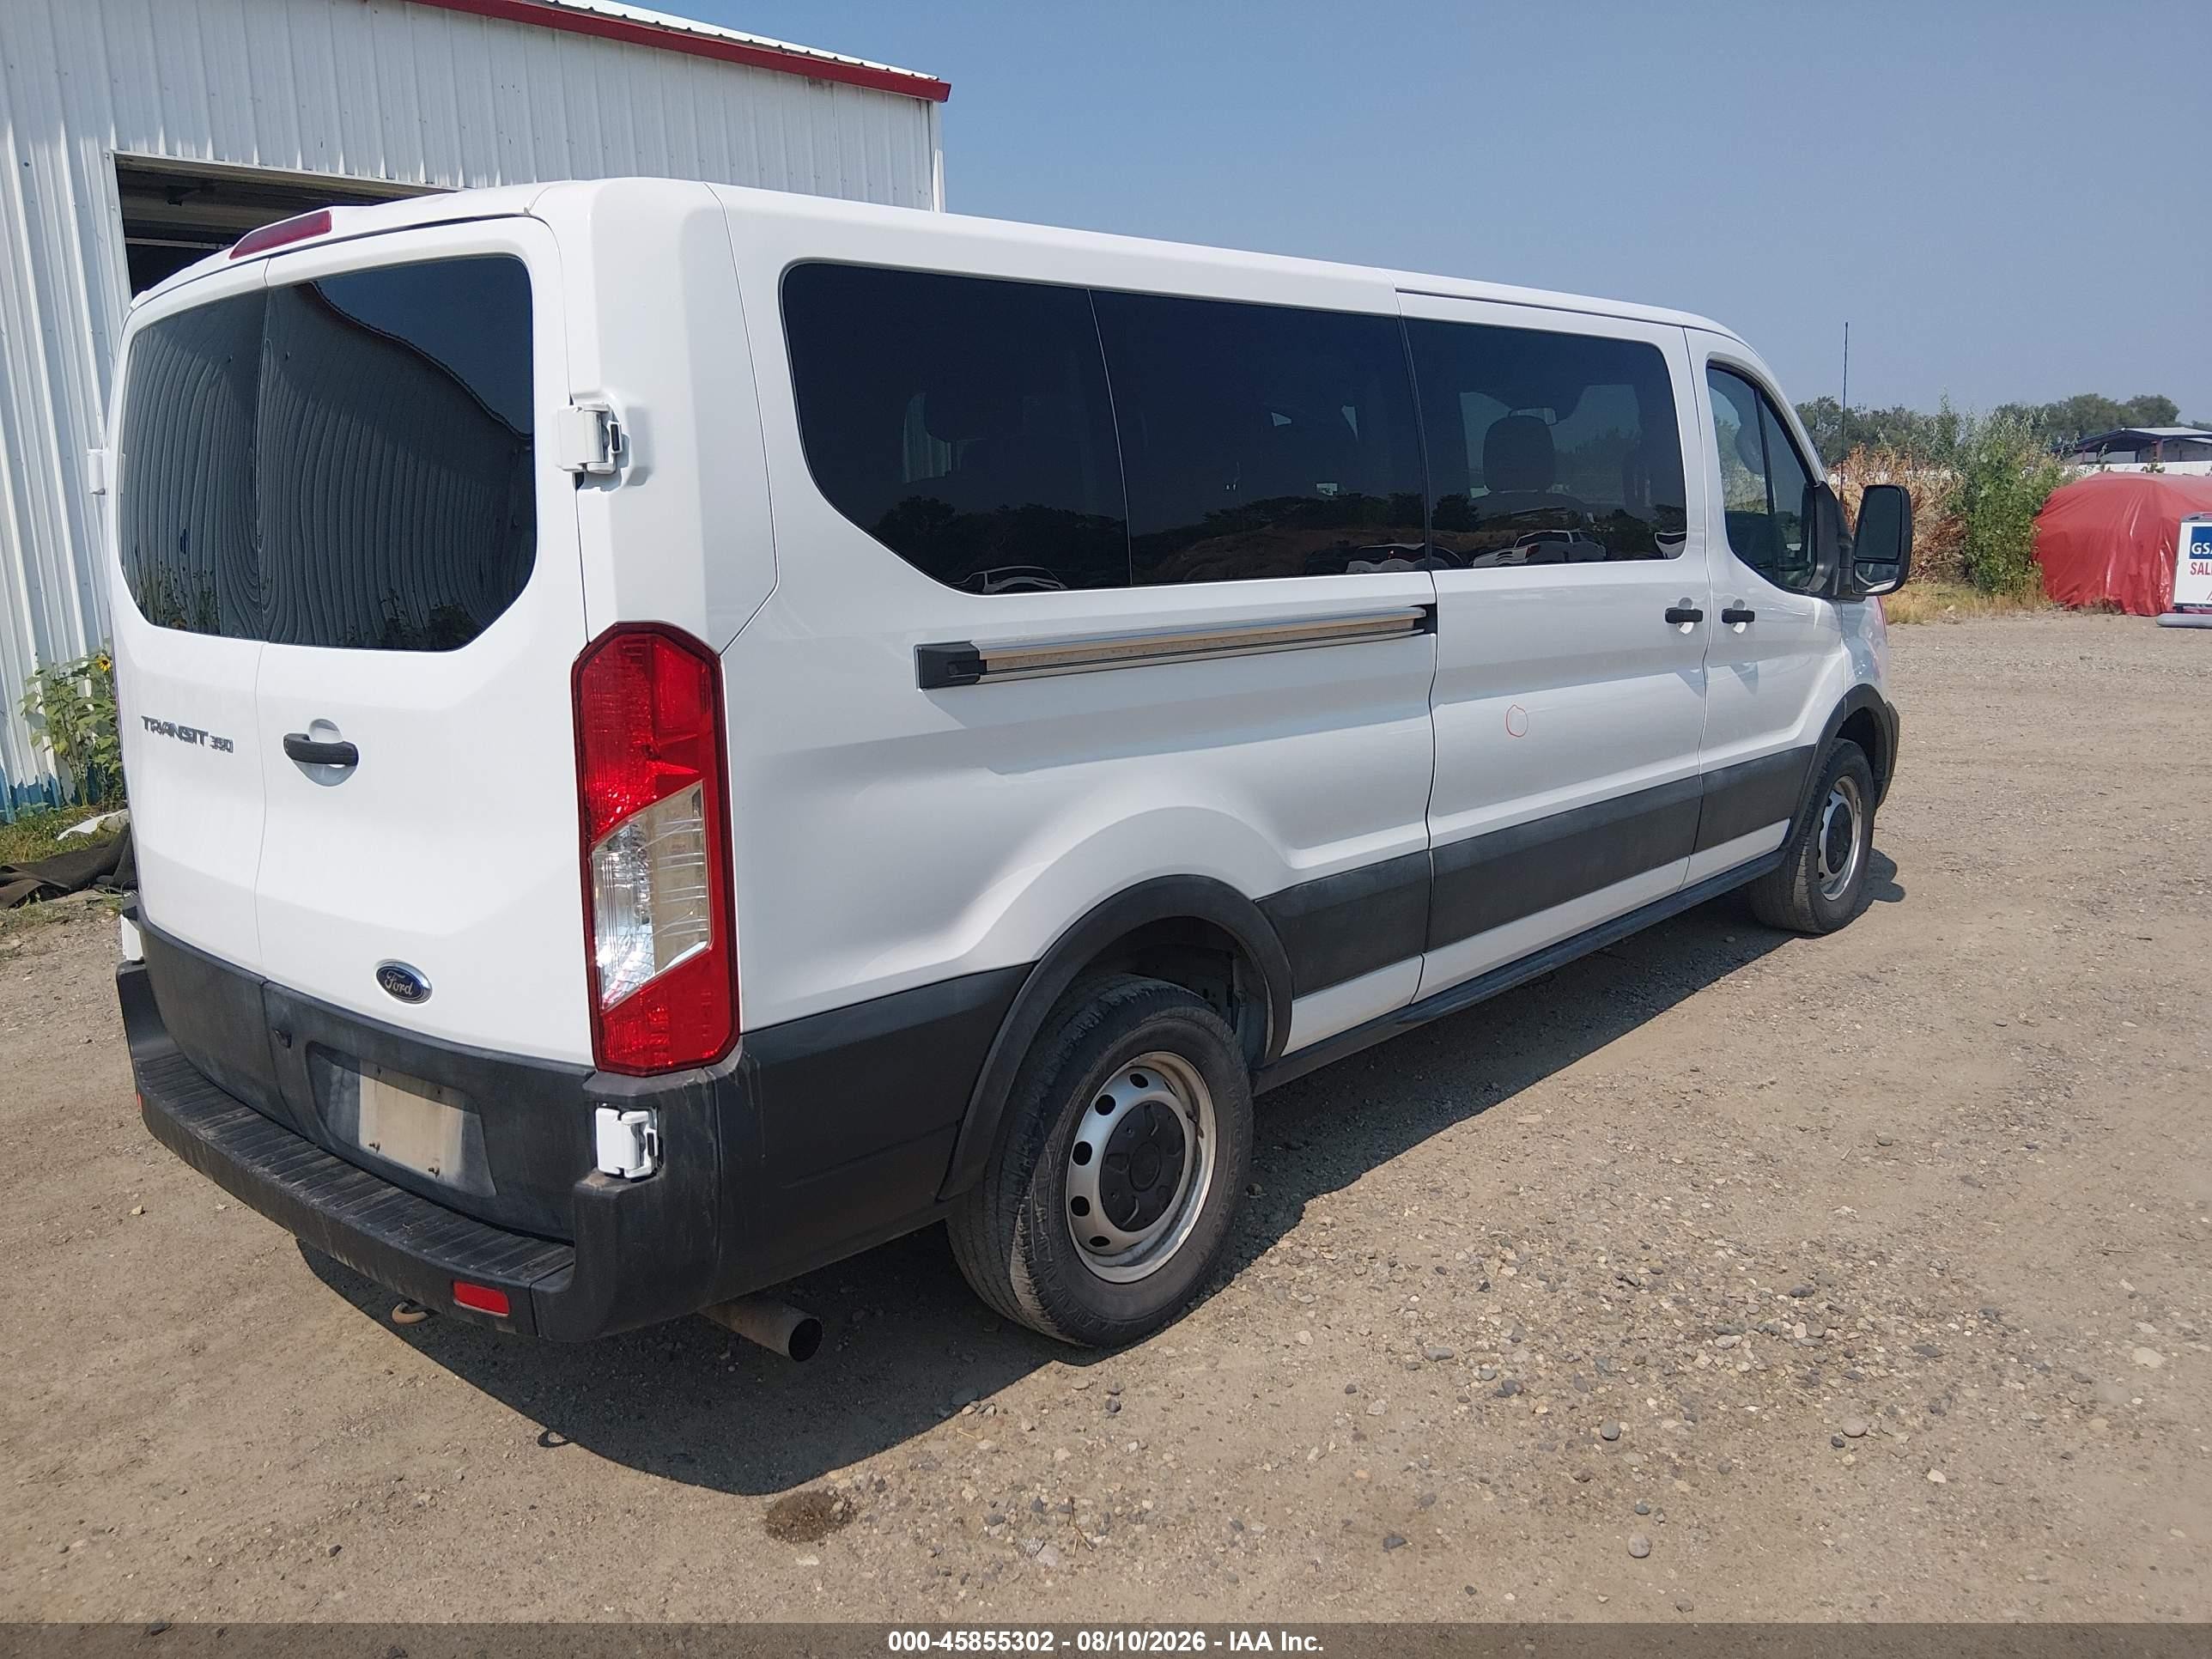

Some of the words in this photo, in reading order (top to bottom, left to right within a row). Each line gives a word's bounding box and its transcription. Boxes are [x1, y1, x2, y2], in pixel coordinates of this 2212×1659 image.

[2191, 542, 2212, 555] GS
[2190, 562, 2212, 575] SAL
[141, 715, 209, 746] TRANSIT
[385, 970, 413, 996] Ford
